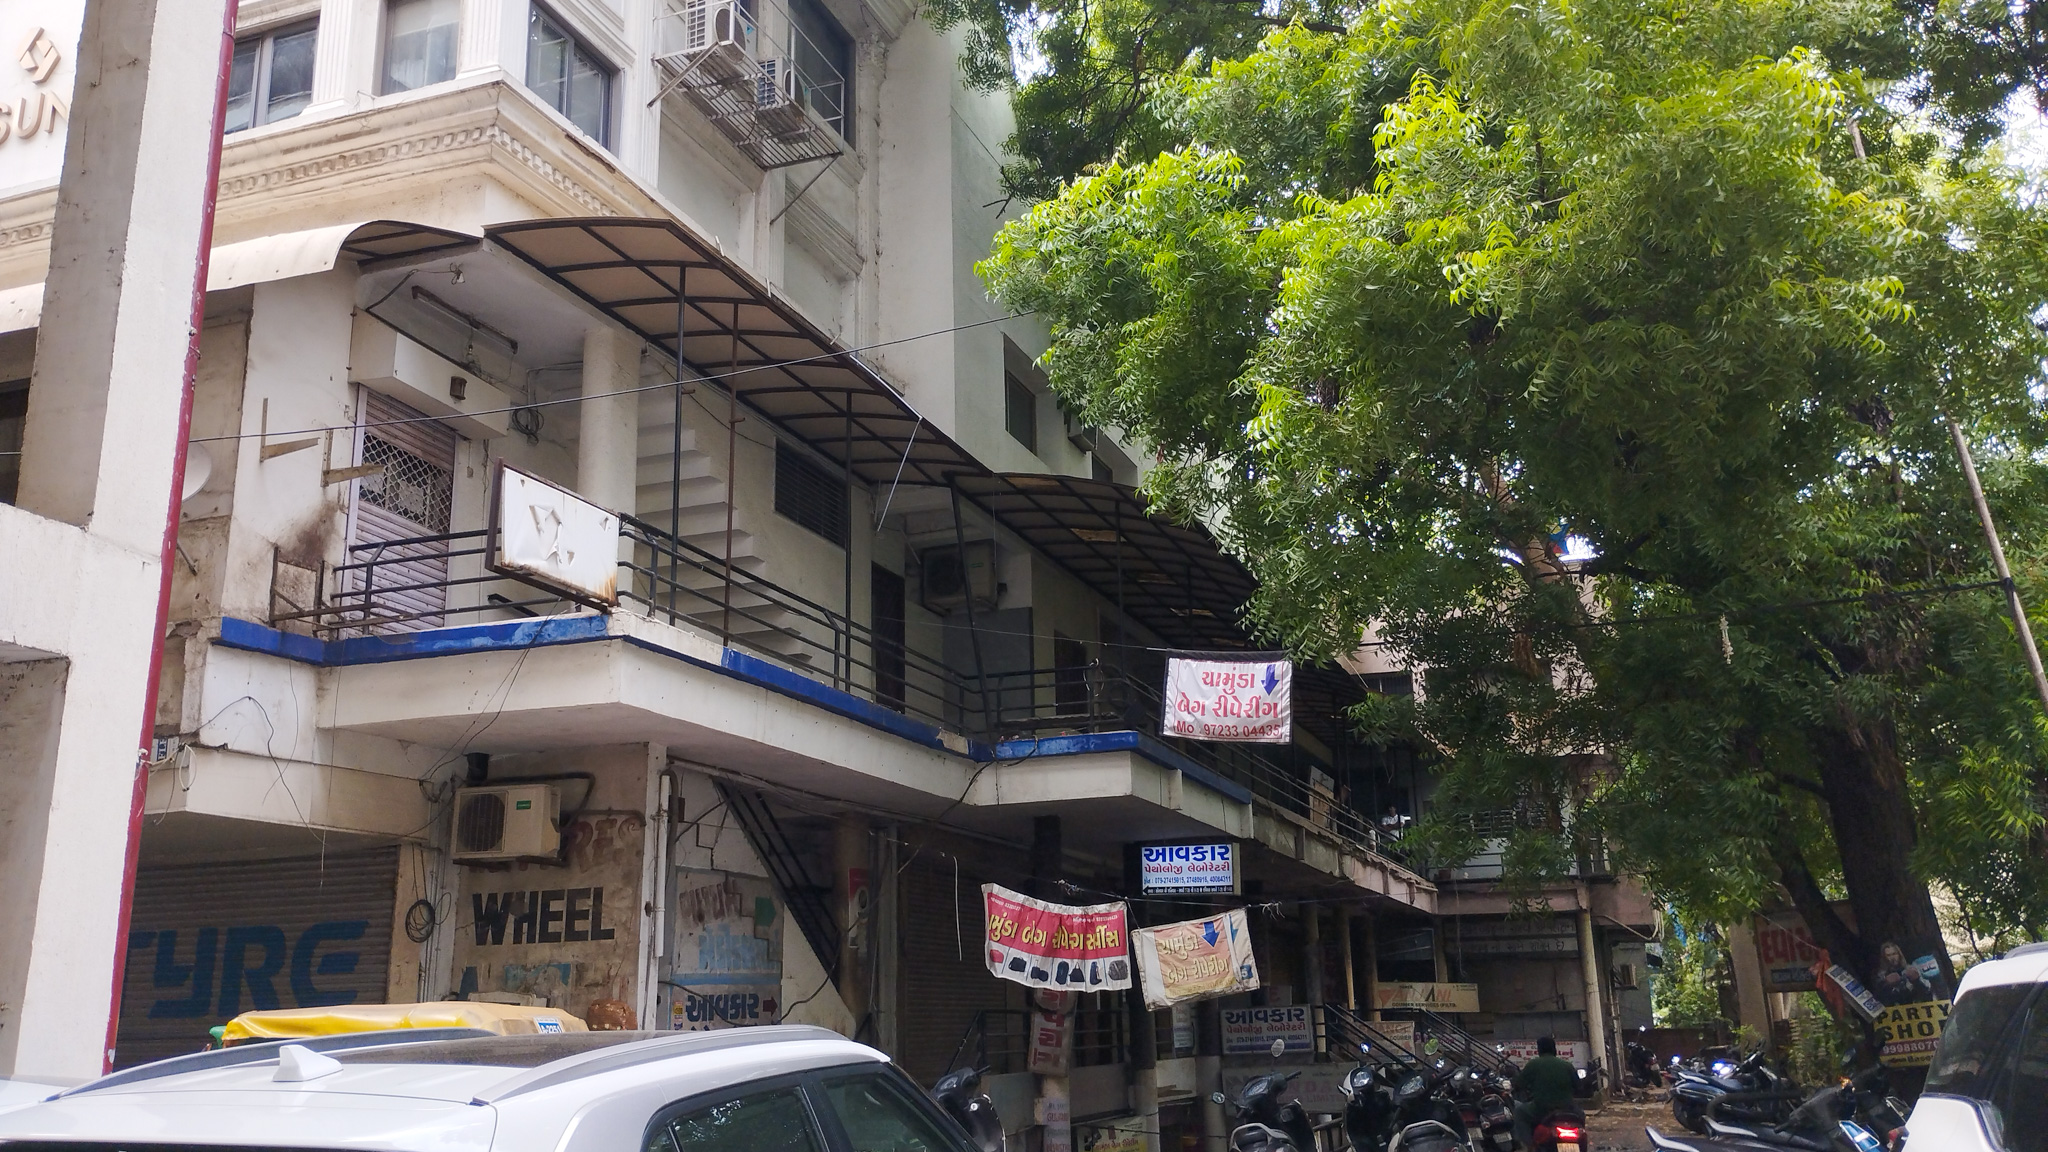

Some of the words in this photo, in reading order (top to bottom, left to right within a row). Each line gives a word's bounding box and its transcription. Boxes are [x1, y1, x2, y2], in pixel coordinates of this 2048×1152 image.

[1202, 667, 1255, 695] ચામુંડા
[1177, 691, 1206, 717] બેગ
[1212, 694, 1279, 719] રીપેરીંગ
[1203, 723, 1239, 737] 97233
[1242, 724, 1281, 738] 04435
[1143, 845, 1230, 863] આવકાર
[1144, 863, 1183, 875] પેથોલોજી
[1187, 861, 1230, 873] લેબોરેટરી
[472, 886, 615, 946] WHEEL
[1021, 920, 1048, 948] બેગ
[686, 993, 760, 1022] આવકાર
[1225, 1007, 1305, 1024] આવકાર
[1877, 1003, 1950, 1025] PARTY
